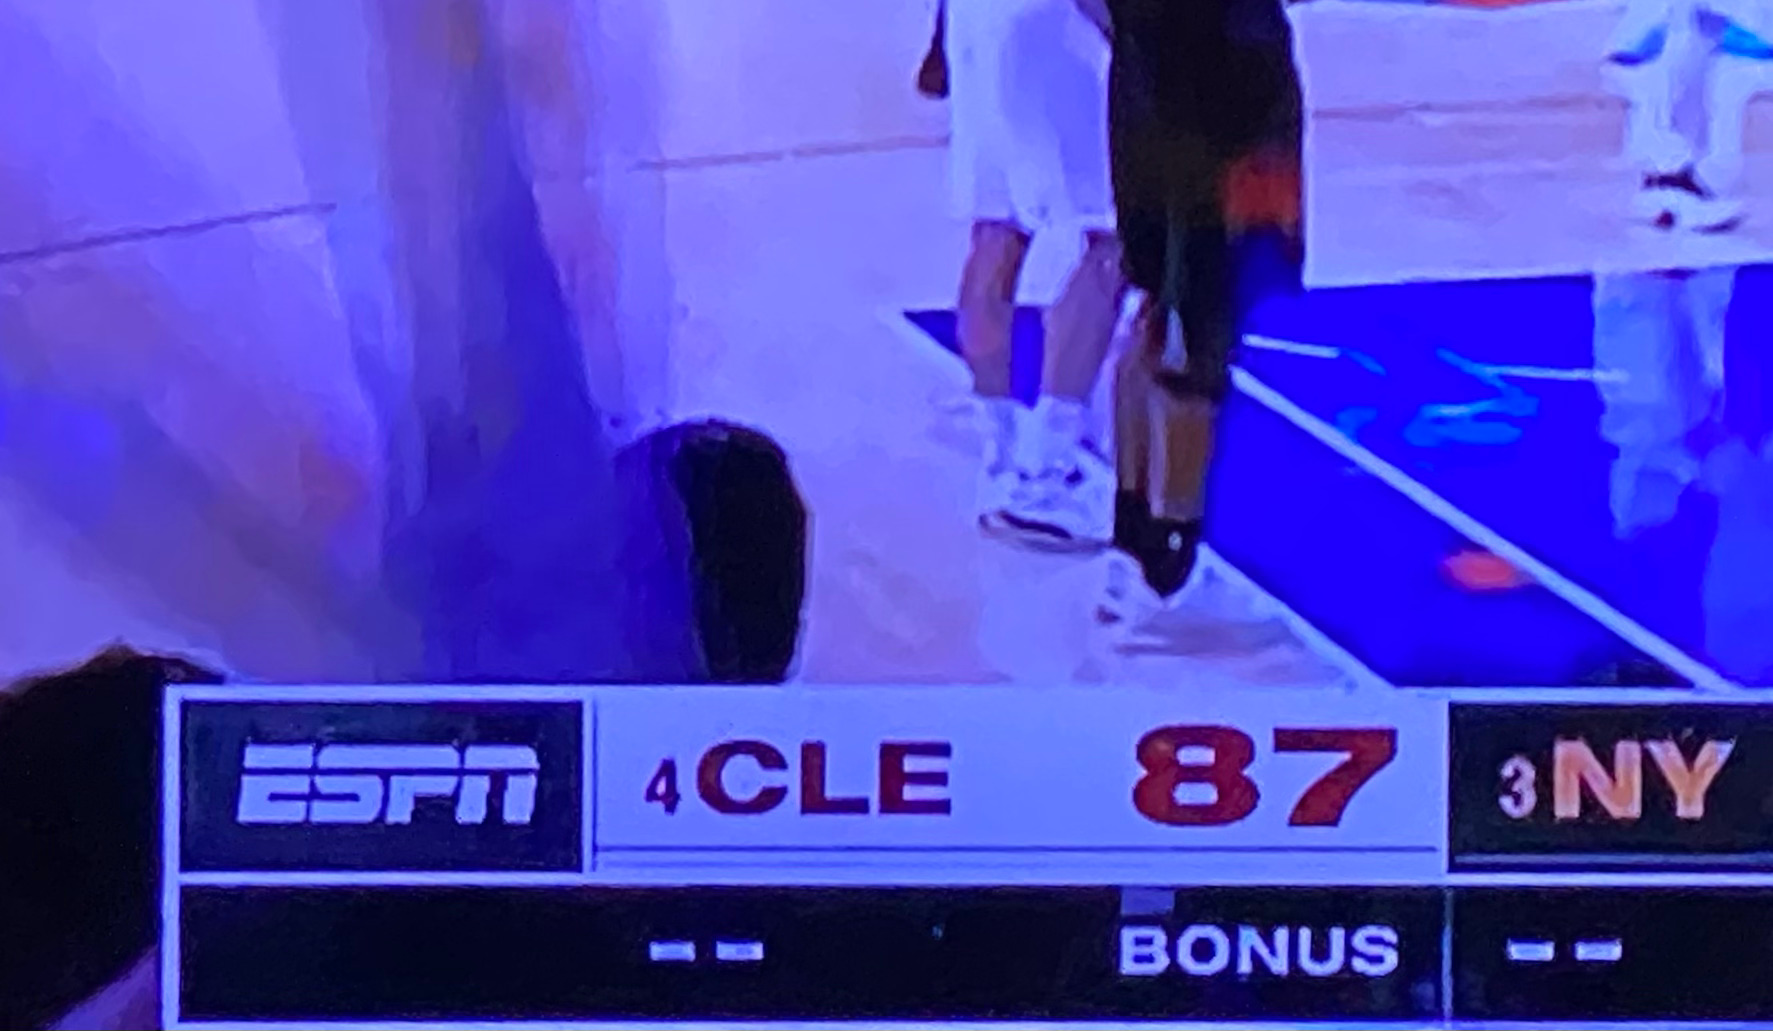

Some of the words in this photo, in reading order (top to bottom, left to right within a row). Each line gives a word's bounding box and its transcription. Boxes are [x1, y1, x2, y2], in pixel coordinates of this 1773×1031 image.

[236, 742, 539, 825] ESPN
[1132, 724, 1397, 827] 87
[1118, 925, 1399, 978] BONUS
